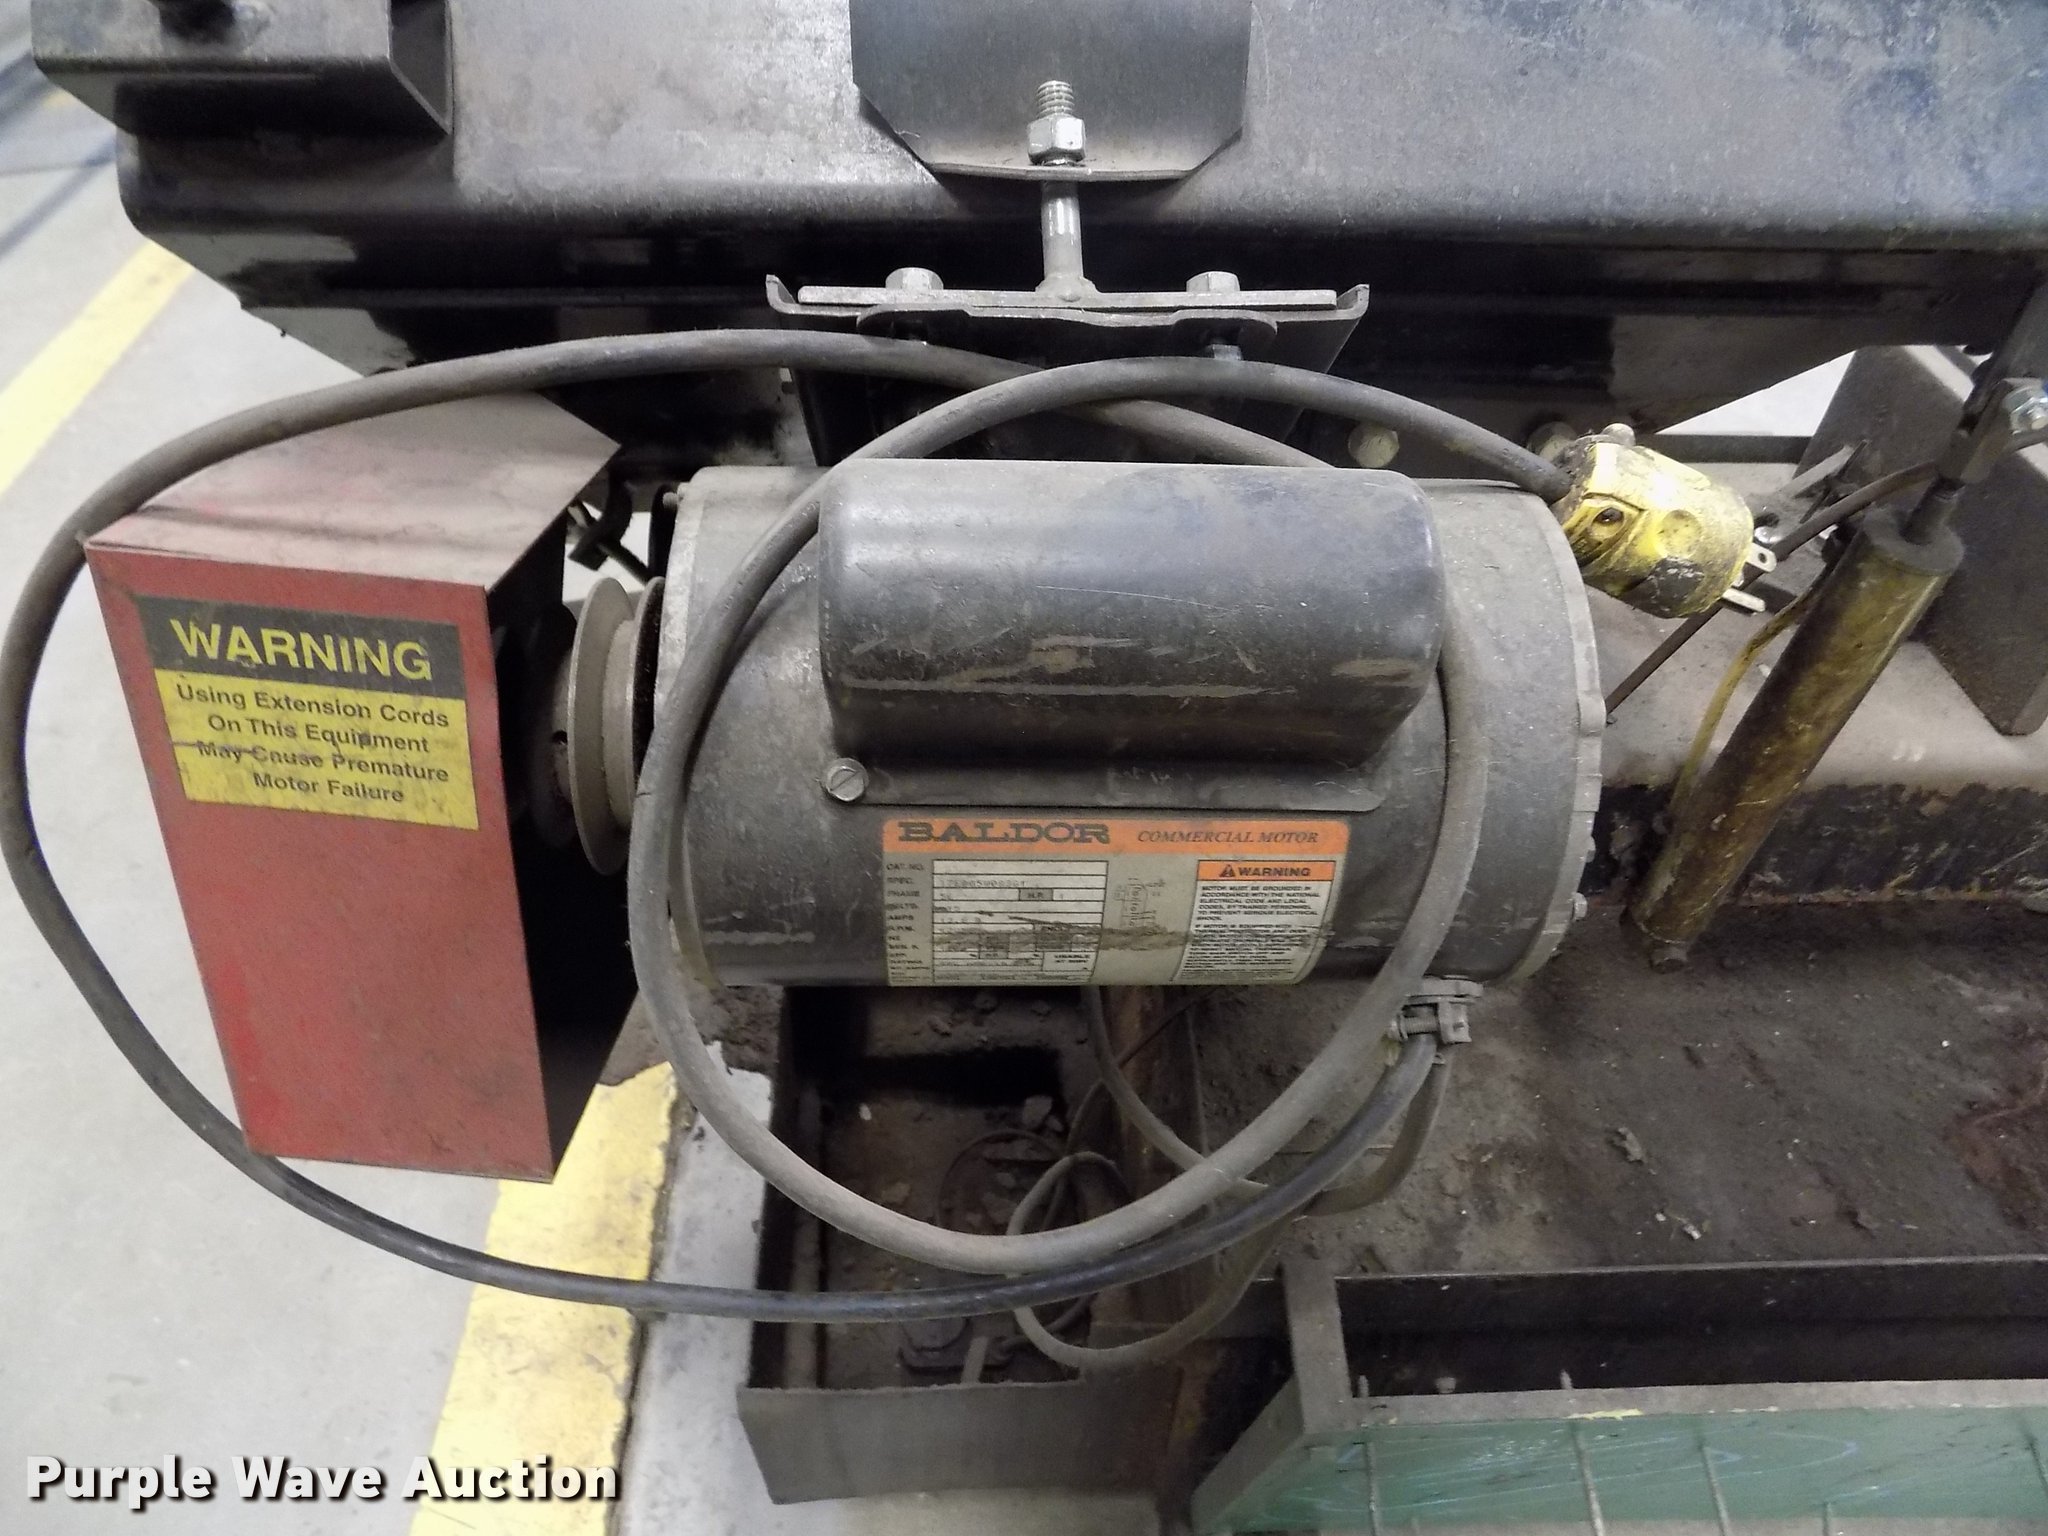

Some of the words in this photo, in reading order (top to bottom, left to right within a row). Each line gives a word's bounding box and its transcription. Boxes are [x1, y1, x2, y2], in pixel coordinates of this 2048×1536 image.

[170, 618, 432, 681] WARNING
[176, 682, 245, 709] Using
[255, 692, 371, 719] Extension
[380, 704, 449, 727] Cords
[208, 714, 241, 733] On
[243, 718, 297, 738] This
[306, 724, 430, 753] Equipment
[198, 741, 242, 763] May
[252, 745, 323, 768] Cause
[333, 754, 449, 782] Premature
[253, 771, 319, 795] Motor
[328, 780, 404, 802] Failure
[898, 821, 1111, 844] BALDOR
[1138, 830, 1257, 843] COMMERCIAL
[1258, 831, 1319, 843] MOTOR
[1238, 866, 1311, 878] WARNING
